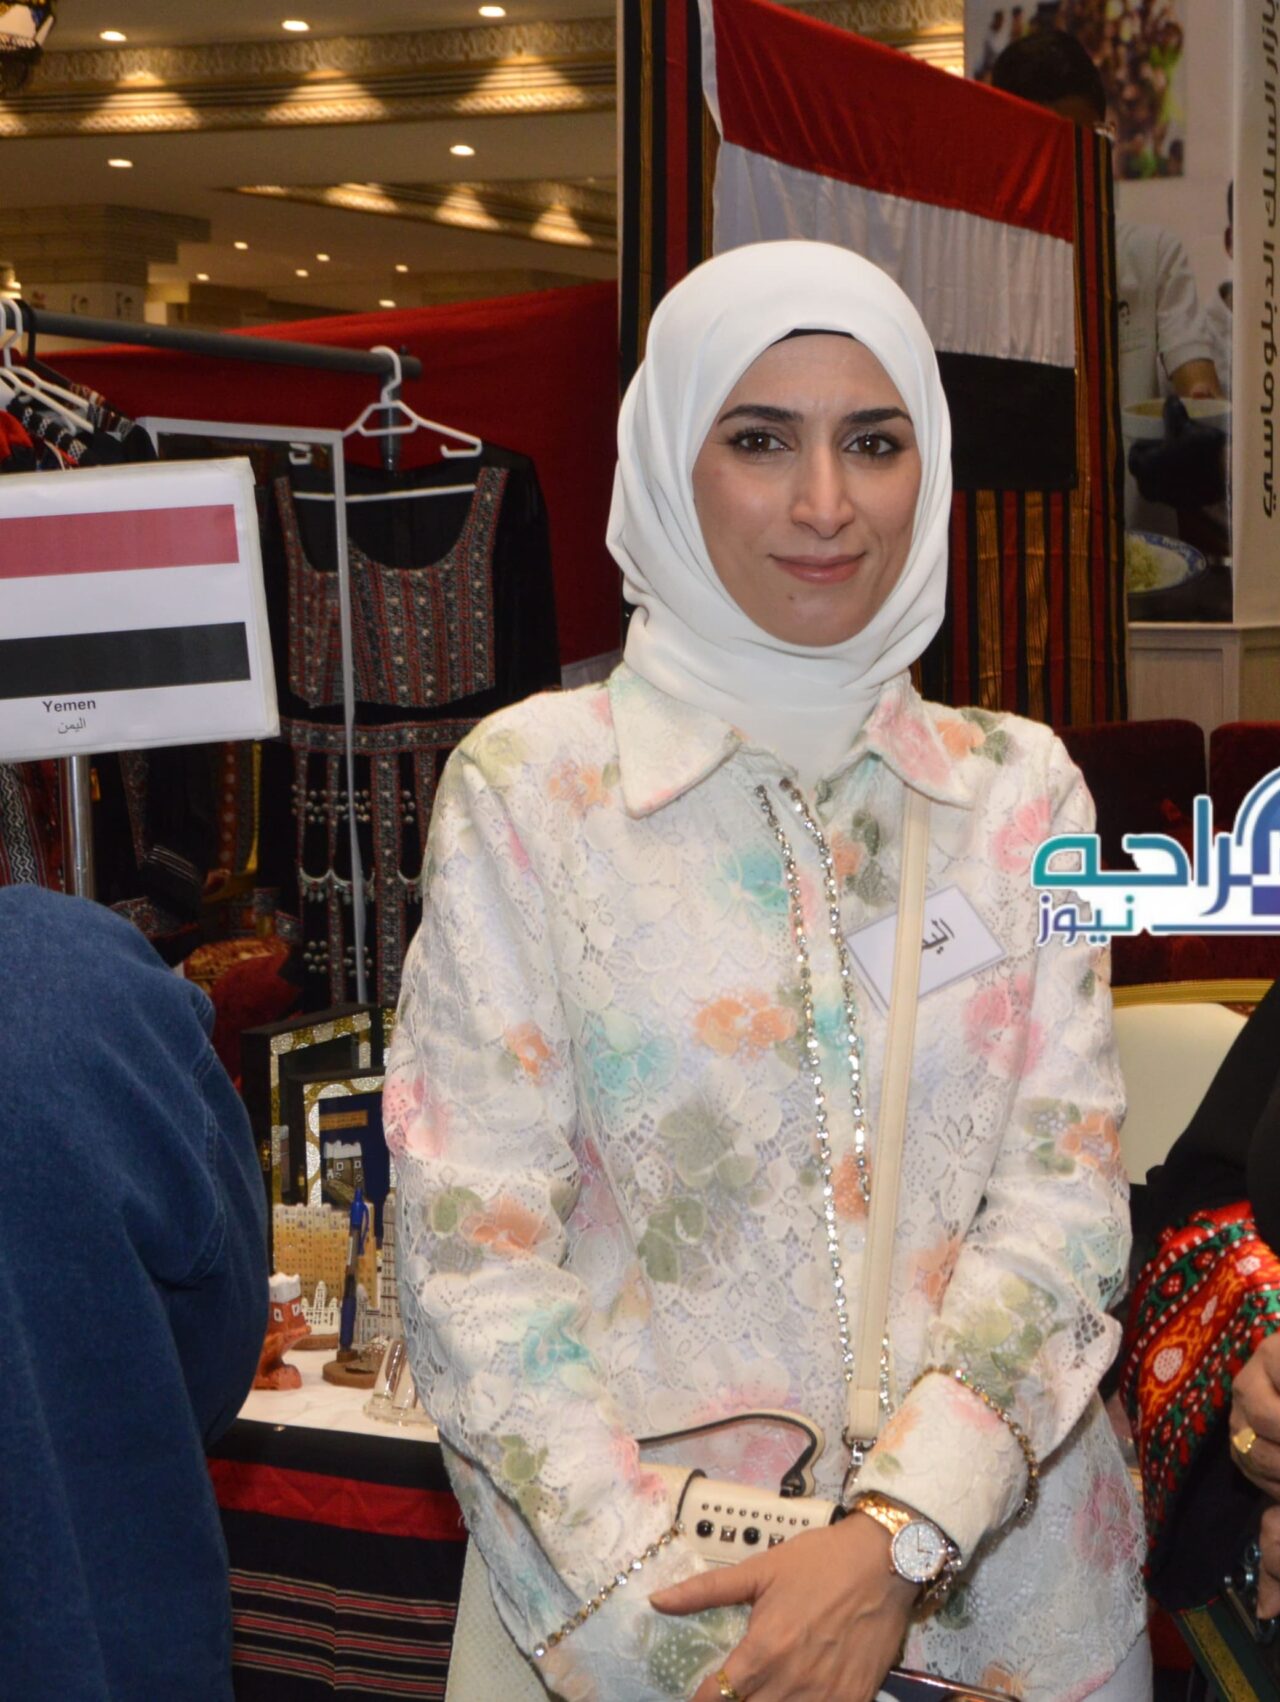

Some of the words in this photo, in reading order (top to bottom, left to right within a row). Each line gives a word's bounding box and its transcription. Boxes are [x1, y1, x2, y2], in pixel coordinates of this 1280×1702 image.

[1263, 80, 1277, 228] السلك
[1260, 240, 1278, 519] الدبلوماسي
[42, 700, 97, 713] Yemen
[57, 716, 87, 735] اليمن
[921, 917, 955, 955] الي
